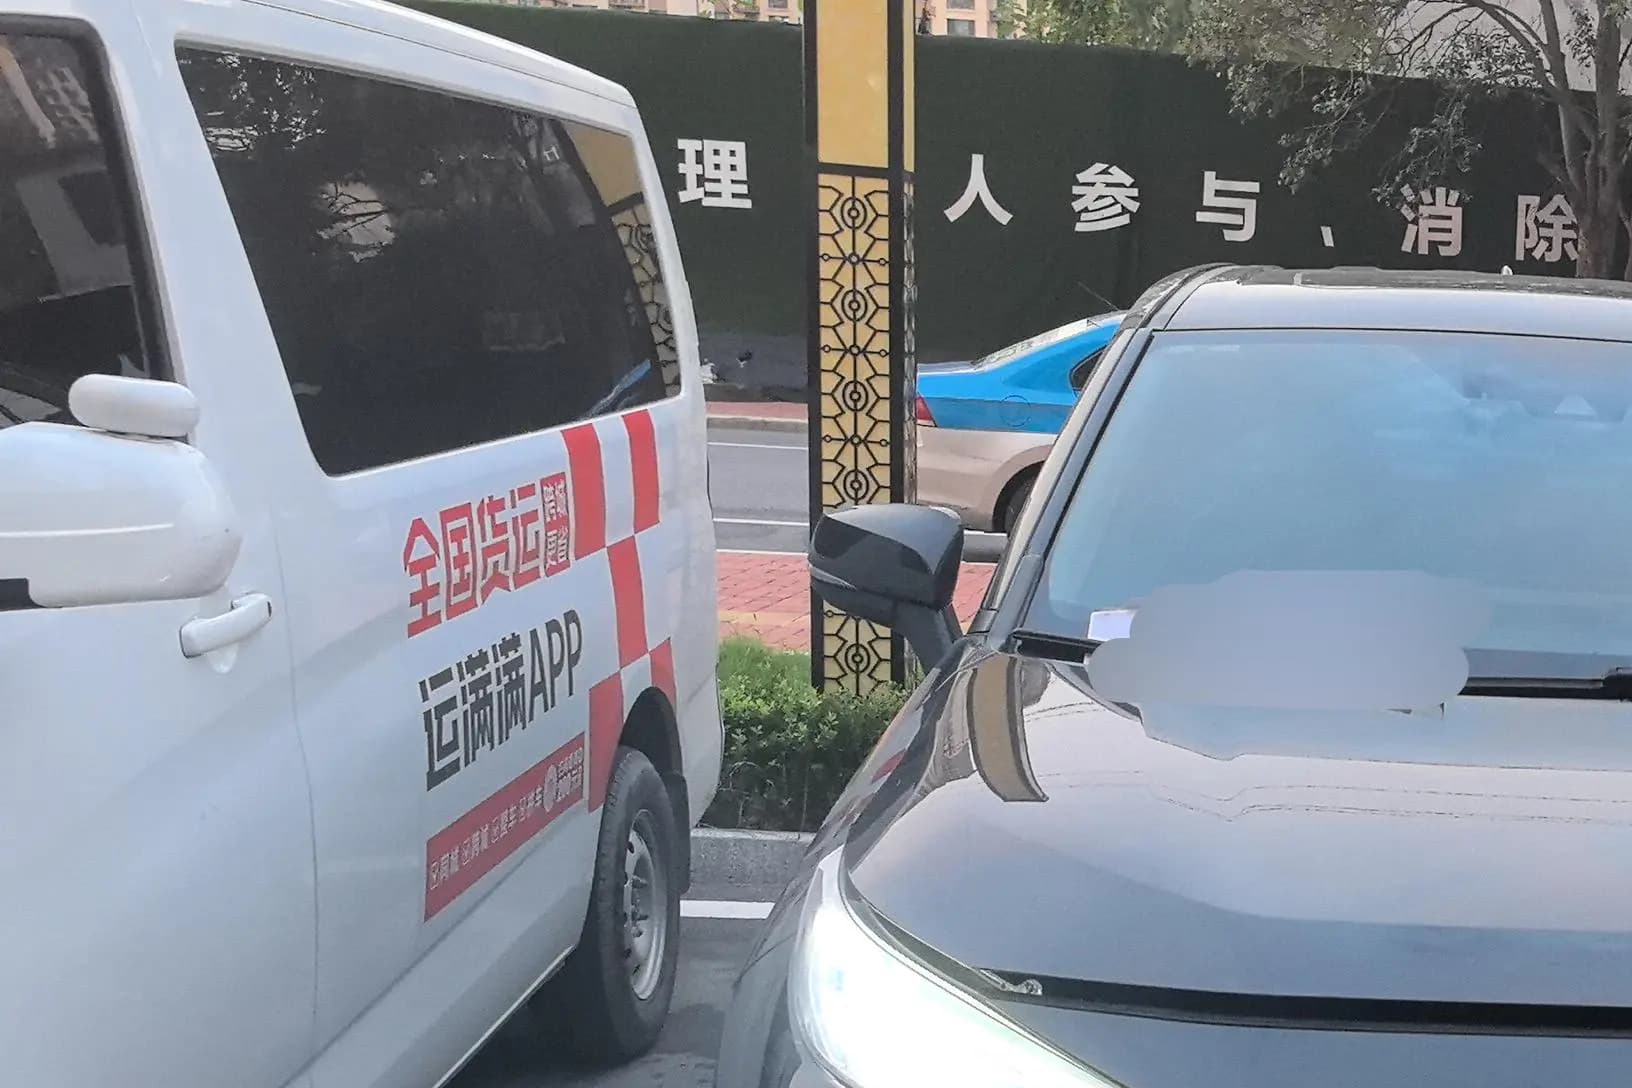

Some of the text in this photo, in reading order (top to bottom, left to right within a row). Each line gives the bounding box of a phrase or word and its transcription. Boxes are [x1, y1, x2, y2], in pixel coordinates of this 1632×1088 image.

[403, 483, 541, 638] 全国货运
[419, 609, 583, 792] 运满满APP
